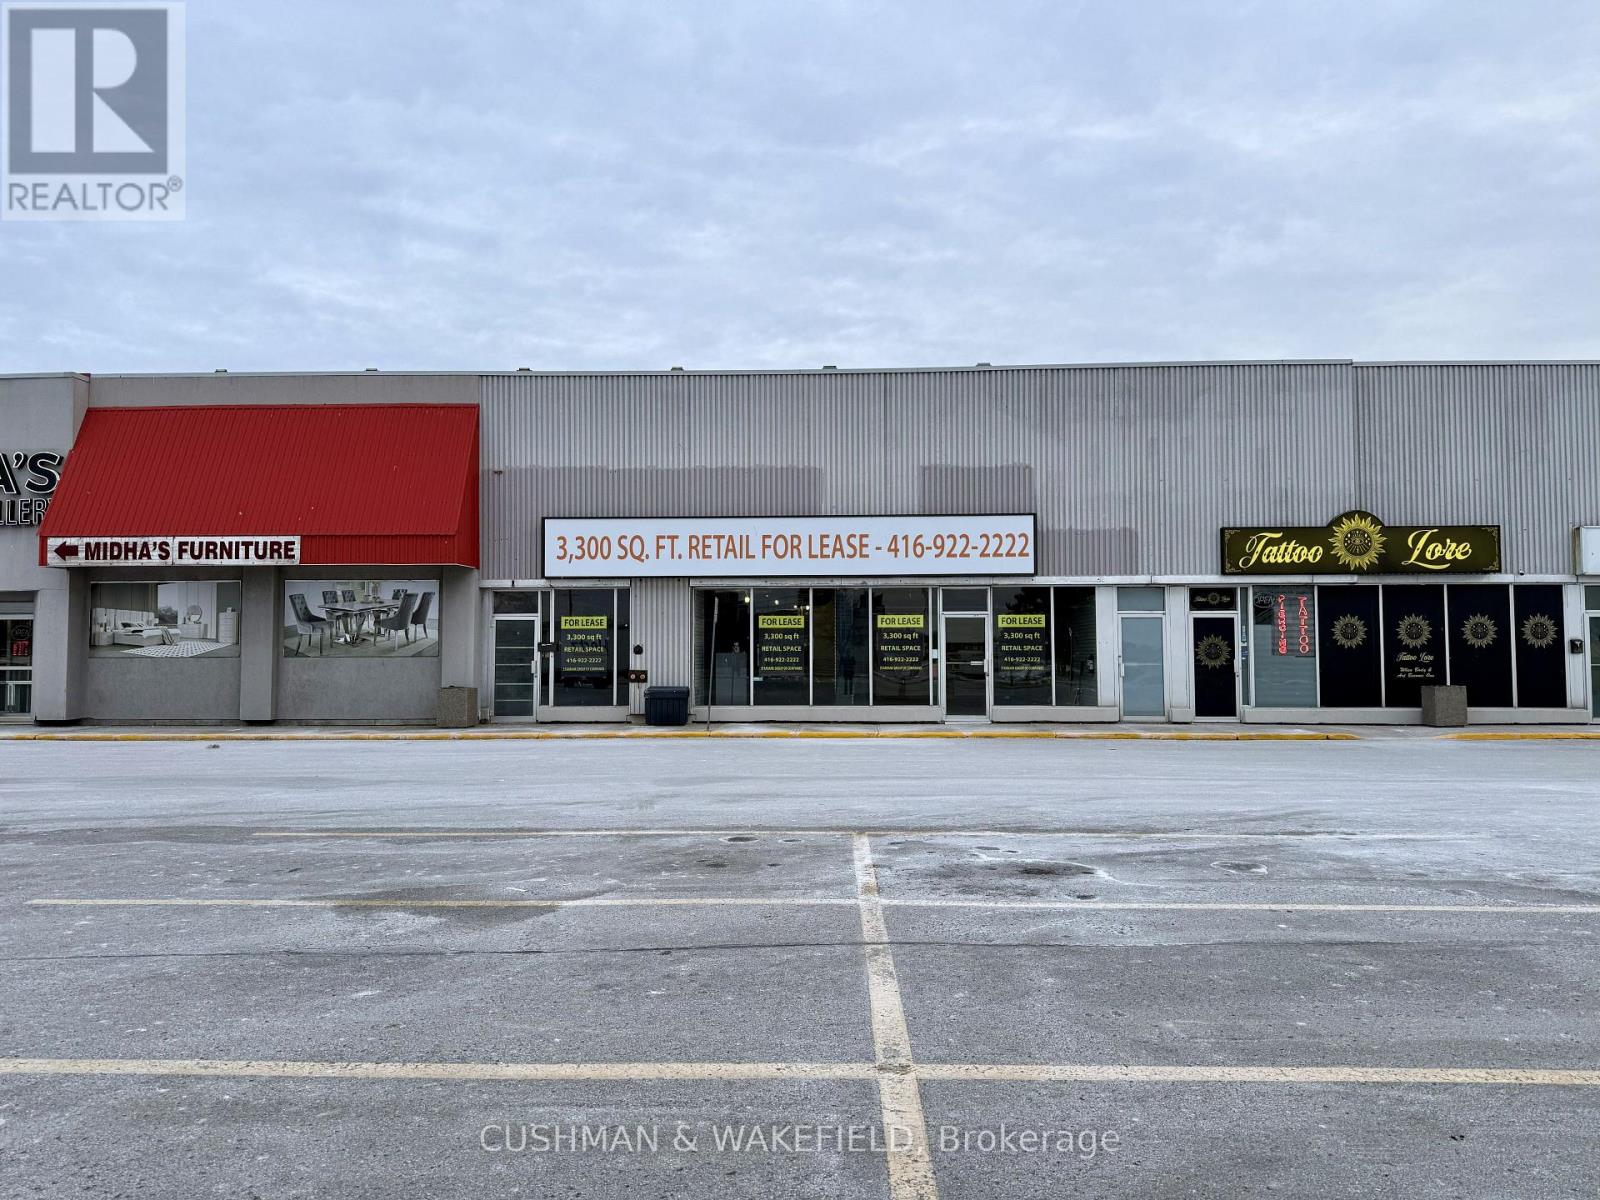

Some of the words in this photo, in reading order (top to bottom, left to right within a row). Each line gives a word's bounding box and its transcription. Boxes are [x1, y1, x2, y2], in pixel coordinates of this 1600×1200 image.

[0, 498, 52, 526] LER
[84, 540, 171, 561] MIDHA'S
[177, 540, 296, 561] FURNITURE
[556, 535, 612, 564] 3,300
[617, 534, 650, 563] SQ.
[655, 534, 682, 560] FT.
[688, 534, 756, 560] RETAIL
[761, 534, 802, 560] FOR
[808, 533, 870, 559] LEASE
[887, 532, 1030, 559] 416-922-2222
[1238, 531, 1324, 569] Tattoo
[1401, 528, 1472, 570] Lore
[564, 618, 579, 627] FOR
[581, 618, 605, 627] LEASE
[761, 618, 778, 626] FOR
[778, 618, 802, 626] LEASE
[880, 617, 896, 625] FOR
[897, 617, 921, 625] LEASE
[1001, 617, 1017, 625] FOR
[1018, 617, 1043, 625] LEASE
[1298, 596, 1309, 654] TATTOO
[883, 632, 902, 640] 3,300
[903, 633, 912, 641] sq
[1003, 632, 1023, 640] 3,300
[1024, 633, 1033, 641] sq
